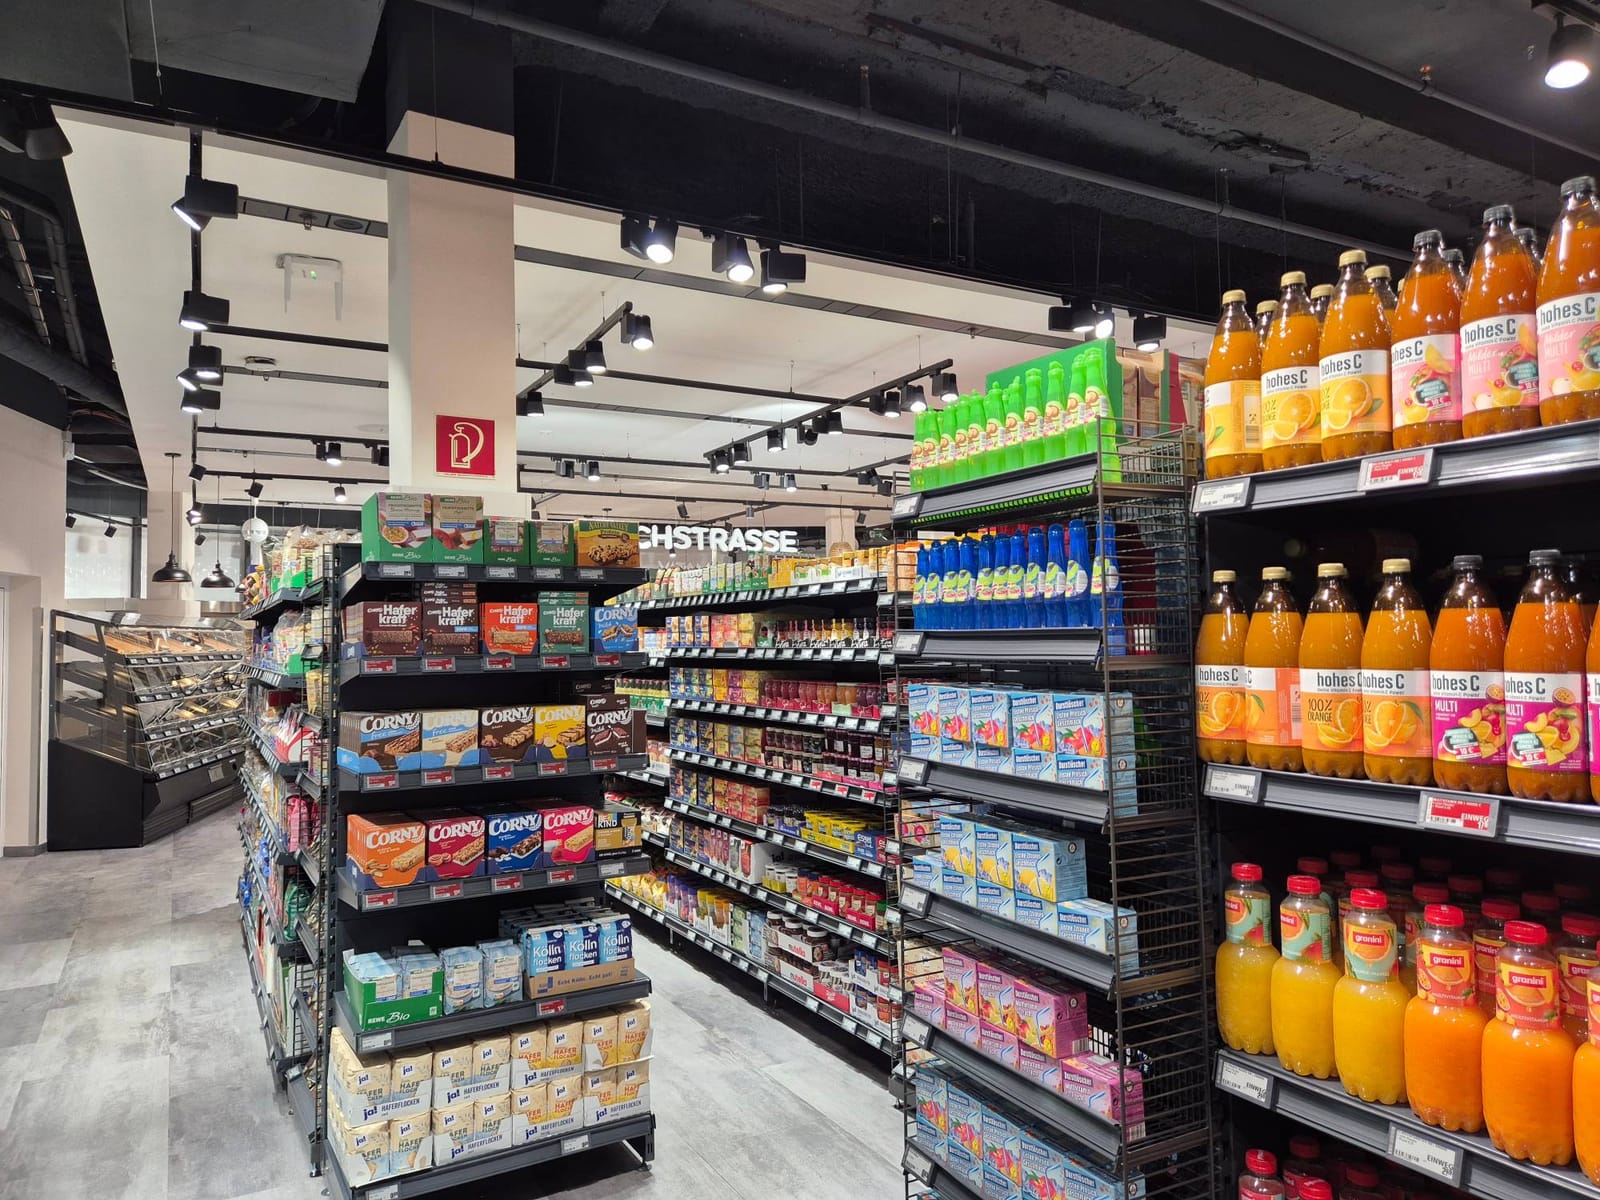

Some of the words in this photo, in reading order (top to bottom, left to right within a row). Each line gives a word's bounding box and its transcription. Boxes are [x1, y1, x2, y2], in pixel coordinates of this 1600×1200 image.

[1540, 302, 1582, 327] hohes
[1585, 297, 1596, 315] C
[1464, 323, 1504, 345] hohes
[1506, 318, 1516, 335] C
[1415, 340, 1423, 356] C
[1353, 353, 1362, 369] C
[1265, 373, 1298, 390] hohes
[1300, 369, 1308, 384] C
[383, 604, 418, 617] Hafer
[442, 606, 474, 618] Hafer
[503, 605, 533, 616] Hafer
[556, 607, 585, 618] Hafer
[595, 607, 638, 623] CORNY
[379, 613, 407, 625] kraft
[438, 615, 465, 626] kraft
[500, 613, 525, 625] kraft
[553, 615, 577, 626] kraft
[1199, 667, 1230, 681] hohes
[1231, 667, 1239, 682] C
[1317, 671, 1356, 687] hohes
[1363, 672, 1394, 689] hohes
[1395, 673, 1405, 689] C
[1432, 674, 1468, 692] hohes
[1470, 675, 1480, 692] C
[1505, 676, 1533, 694] ohes
[1535, 677, 1546, 695] C
[1308, 699, 1333, 711] 100%
[1434, 700, 1458, 713] MULTI
[481, 706, 534, 727] CORNY
[535, 705, 586, 725] CORNY
[587, 709, 632, 728] CORNY
[1307, 711, 1333, 722] ORANGE
[360, 711, 420, 734] CORNY
[488, 813, 542, 836] CORNY
[543, 808, 594, 830] CORNY
[598, 820, 618, 828] KIND
[366, 825, 425, 849] CORNY
[428, 819, 485, 843] CORNY
[603, 934, 630, 947] Kölln
[1355, 933, 1382, 944] granini
[569, 938, 598, 952] Kölln
[603, 945, 630, 956] flocken
[533, 945, 561, 958] Kölln
[569, 951, 598, 961] flocken
[533, 955, 562, 966] flocken
[1432, 955, 1462, 965] granini
[1571, 964, 1589, 975] gran
[1511, 975, 1544, 986] granini
[386, 1011, 411, 1024] Bio
[626, 1018, 636, 1028] ja!
[593, 1026, 603, 1036] ja!
[519, 1037, 529, 1047] ja!
[555, 1033, 566, 1043] ja!
[597, 1040, 613, 1048] AFER
[482, 1049, 492, 1059] ja!
[553, 1047, 577, 1055] HAFER
[441, 1057, 452, 1067] ja!
[480, 1064, 500, 1072] HAFE
[402, 1065, 413, 1076] ja!
[450, 1070, 465, 1079] FER
[524, 1071, 537, 1085] ja!
[540, 1065, 575, 1077] HAFERFLOCKEN
[626, 1070, 636, 1080] ja!
[358, 1073, 369, 1085] ja!
[400, 1080, 420, 1090] HAFE
[590, 1077, 601, 1088] ja!
[446, 1089, 461, 1103] ja!
[463, 1081, 500, 1095] HAFERFLOCKEN
[556, 1086, 566, 1096] ja!
[519, 1095, 529, 1106] ja!
[555, 1100, 573, 1109] HAFE
[362, 1105, 378, 1120] ja!
[381, 1097, 420, 1111] HAFERFLOCKEN
[483, 1104, 494, 1115] ja!
[527, 1108, 542, 1117] FER
[595, 1107, 608, 1121] ja!
[610, 1099, 642, 1112] HAFERFLOCKEN
[444, 1114, 455, 1125] ja!
[482, 1119, 500, 1129] HAFE
[400, 1123, 411, 1135] ja!
[525, 1125, 538, 1139] ja!
[541, 1117, 574, 1131] HAFERFLOCKEN
[355, 1135, 367, 1146] ja!
[451, 1145, 465, 1159] ja!
[467, 1134, 503, 1150] HAFERFLOCKEN
